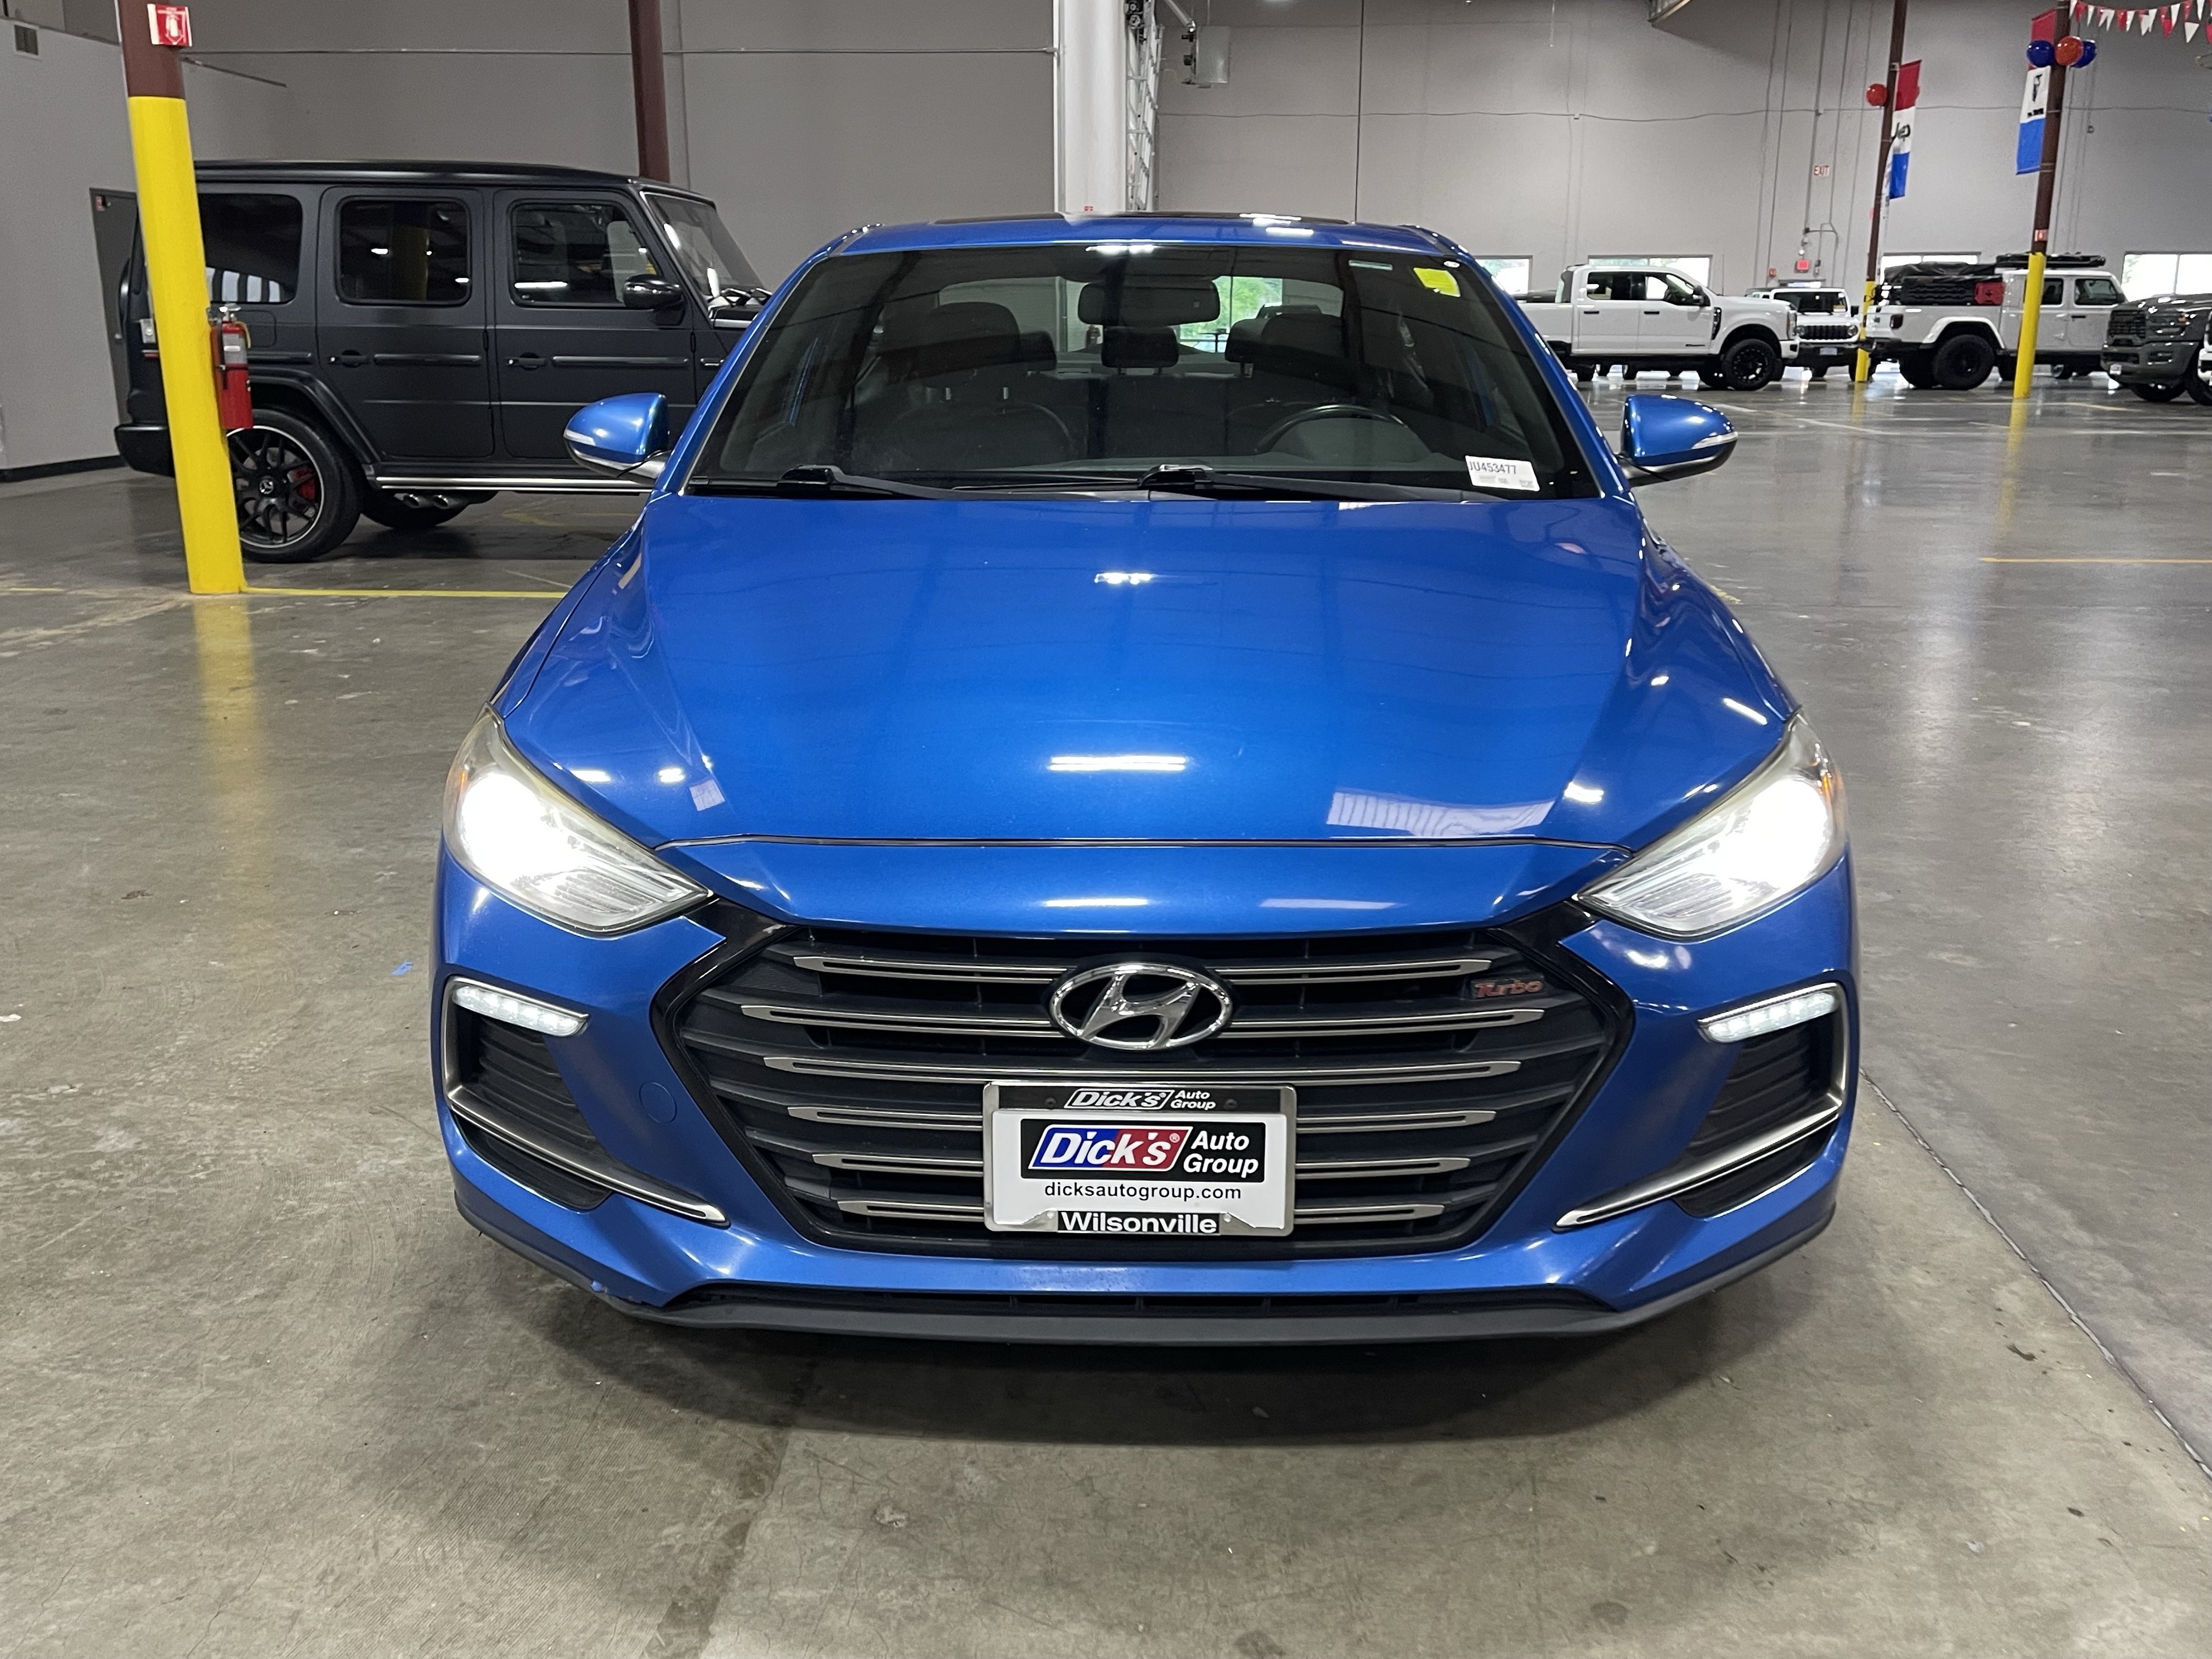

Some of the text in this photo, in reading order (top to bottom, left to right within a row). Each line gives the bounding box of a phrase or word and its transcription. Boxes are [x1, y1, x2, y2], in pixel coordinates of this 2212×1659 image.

[1475, 979, 1543, 998] Turbo
[1171, 1099, 1216, 1111] Group
[1174, 1090, 1211, 1101] Auto
[1190, 1131, 1250, 1151] Auto
[1183, 1154, 1259, 1178] Group
[1045, 1182, 1242, 1201] dicksautogroup.com
[1061, 1211, 1217, 1234] Wilsonville
